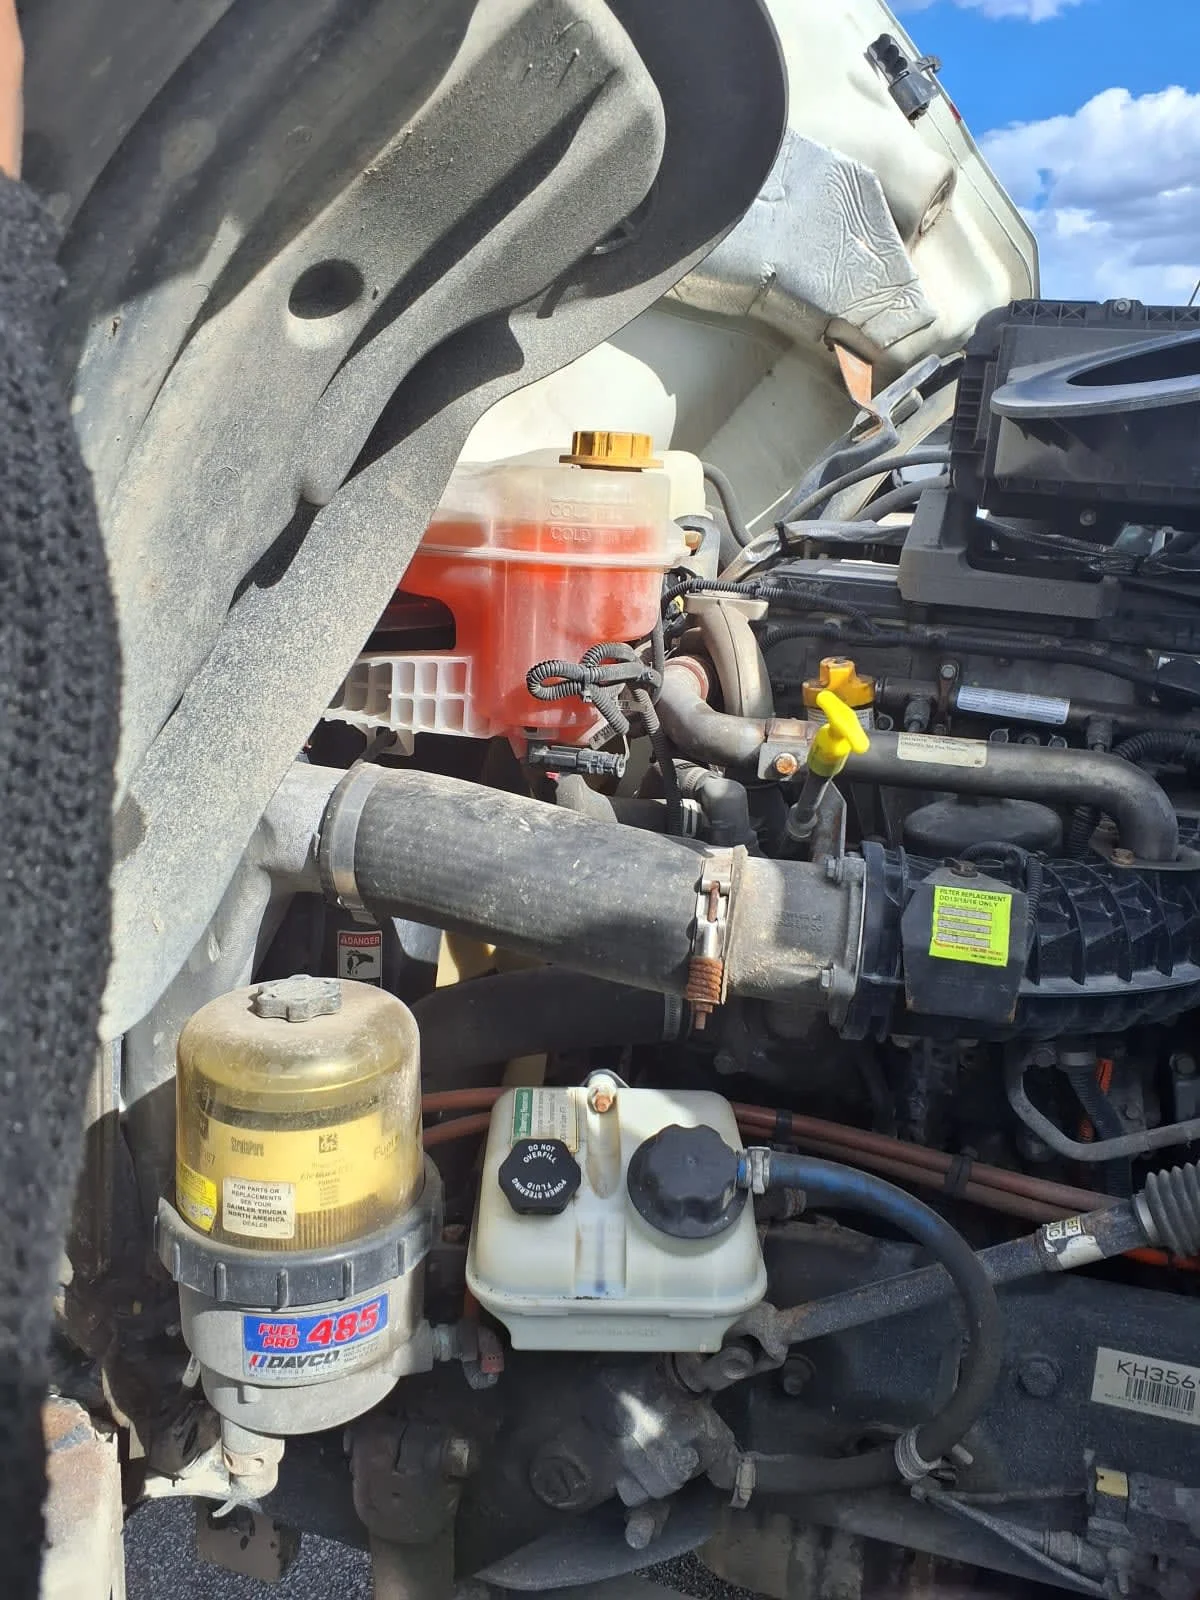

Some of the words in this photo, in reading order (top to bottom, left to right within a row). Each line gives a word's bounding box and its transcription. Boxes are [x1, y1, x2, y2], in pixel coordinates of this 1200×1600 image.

[550, 526, 592, 542] COLD
[961, 891, 1006, 902] REPLACEMENT
[347, 936, 380, 945] DANGER
[528, 1144, 539, 1152] DO
[540, 1144, 556, 1152] NOT
[523, 1151, 557, 1164] OVERFILL
[247, 1185, 268, 1194] PARTS
[511, 1178, 543, 1199] STEERING
[526, 1181, 552, 1190] FLUID
[544, 1179, 567, 1198] POWER
[231, 1189, 282, 1201] REPLACEMENTS
[226, 1202, 256, 1213] DAIMLER
[258, 1208, 287, 1216] TRUCKS
[228, 1210, 251, 1219] NORTH
[252, 1215, 285, 1223] AMERICA
[242, 1220, 268, 1228] DEALER
[258, 1323, 300, 1336] FUEL
[306, 1303, 380, 1345] 485
[263, 1336, 300, 1349] PRO
[1117, 1360, 1200, 1389] KH356
